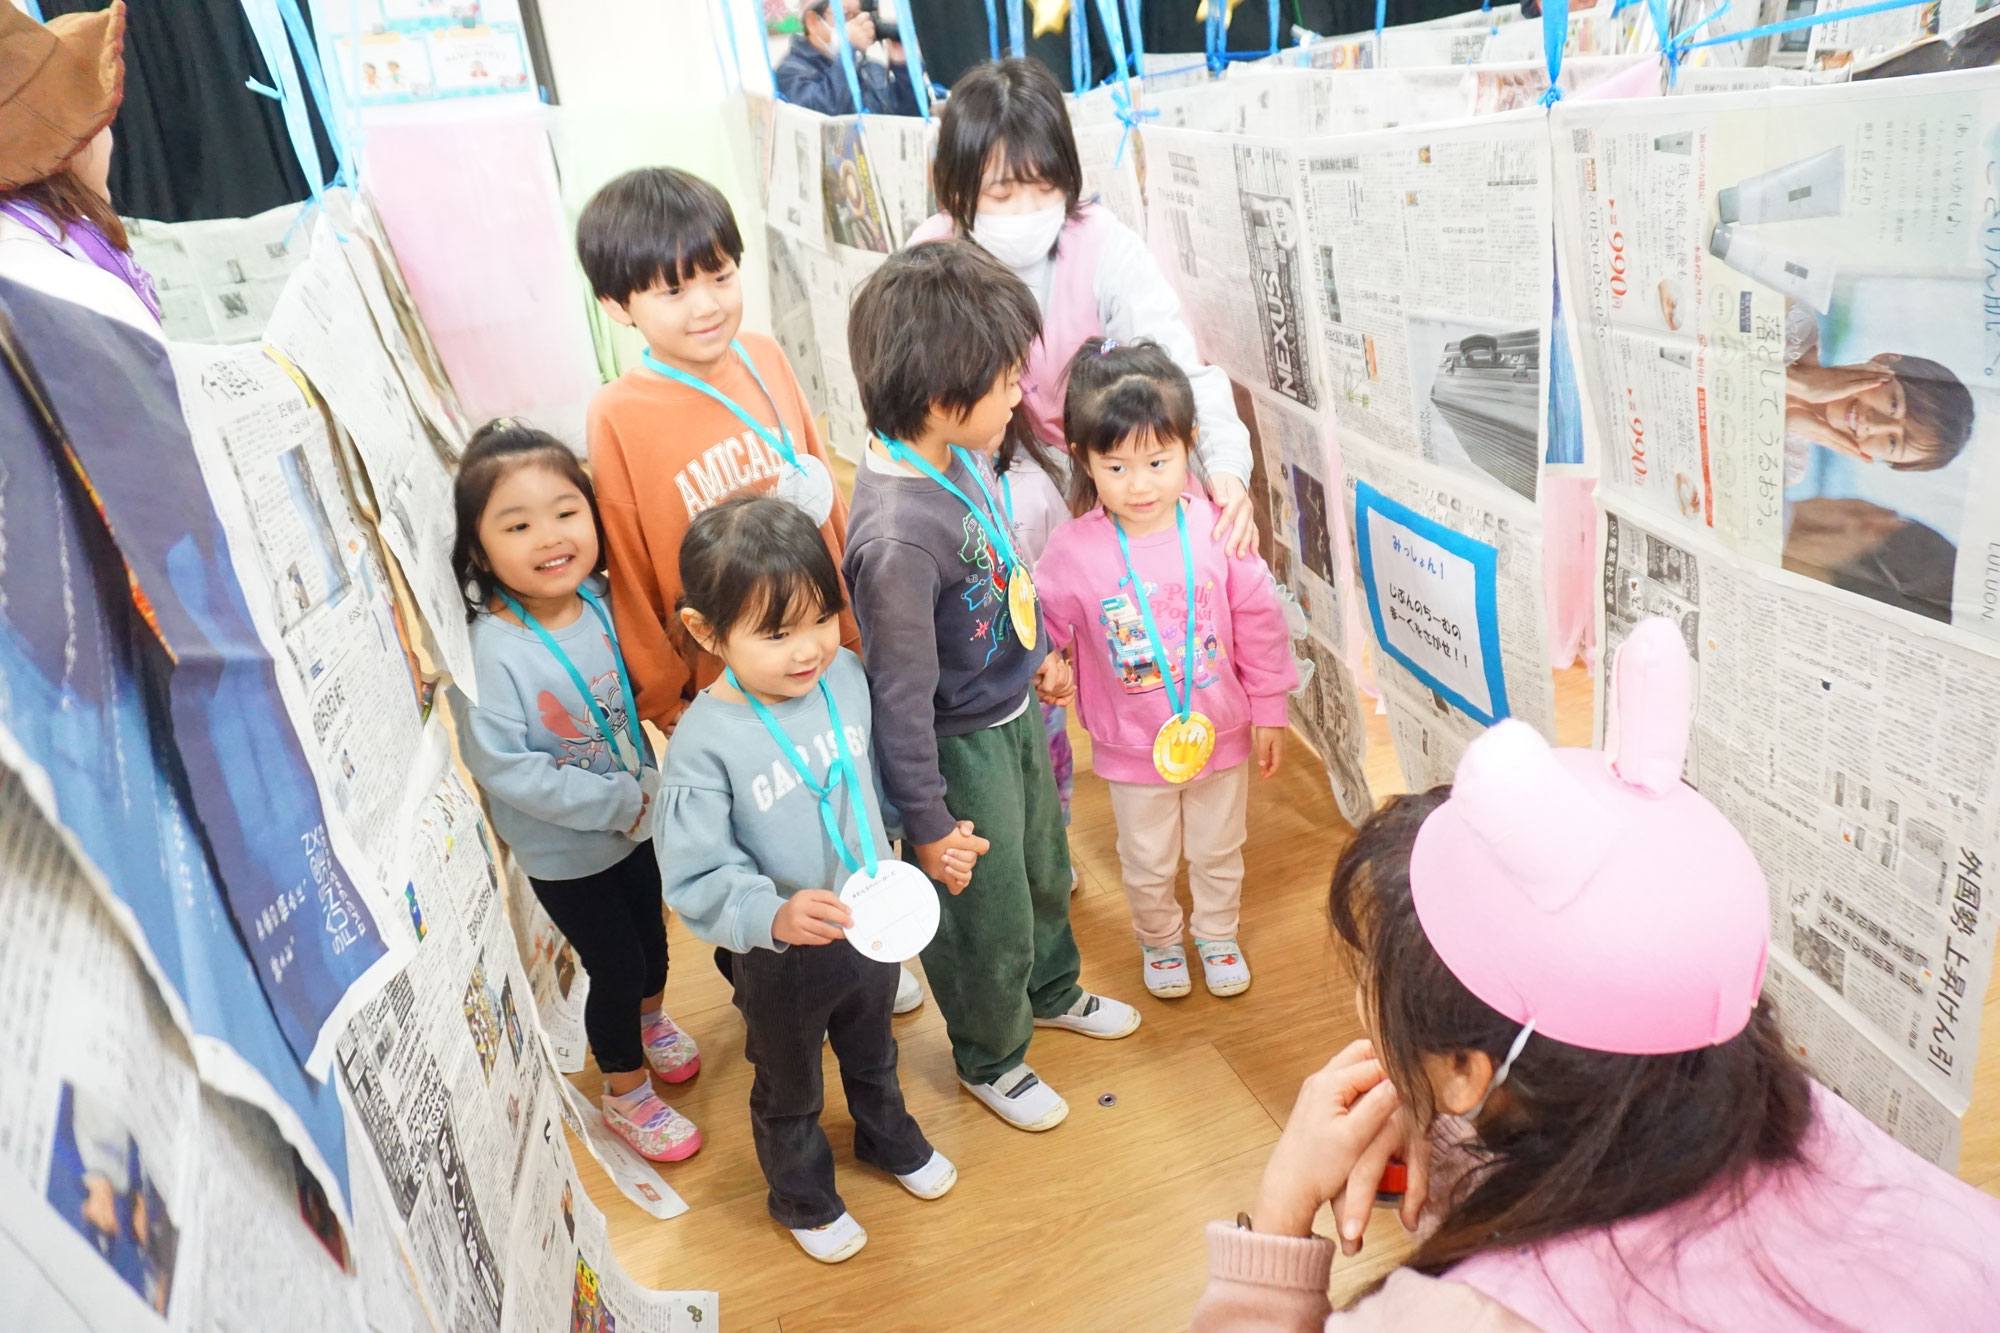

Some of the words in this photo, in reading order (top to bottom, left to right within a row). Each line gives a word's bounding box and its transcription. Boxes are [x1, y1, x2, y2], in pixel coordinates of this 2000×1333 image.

[1587, 211, 1607, 338] 0120-026-026
[1676, 162, 1690, 281] 洗い流した後も
[1262, 270, 1298, 398] NEXUS
[1757, 313, 1781, 528] 落として、うるおう。
[1164, 582, 1212, 608] Polly
[1389, 582, 1463, 642] じぶんのちーむの
[1949, 847, 1984, 937] 外国勢
[1927, 935, 1970, 1077] 上昇けん引
